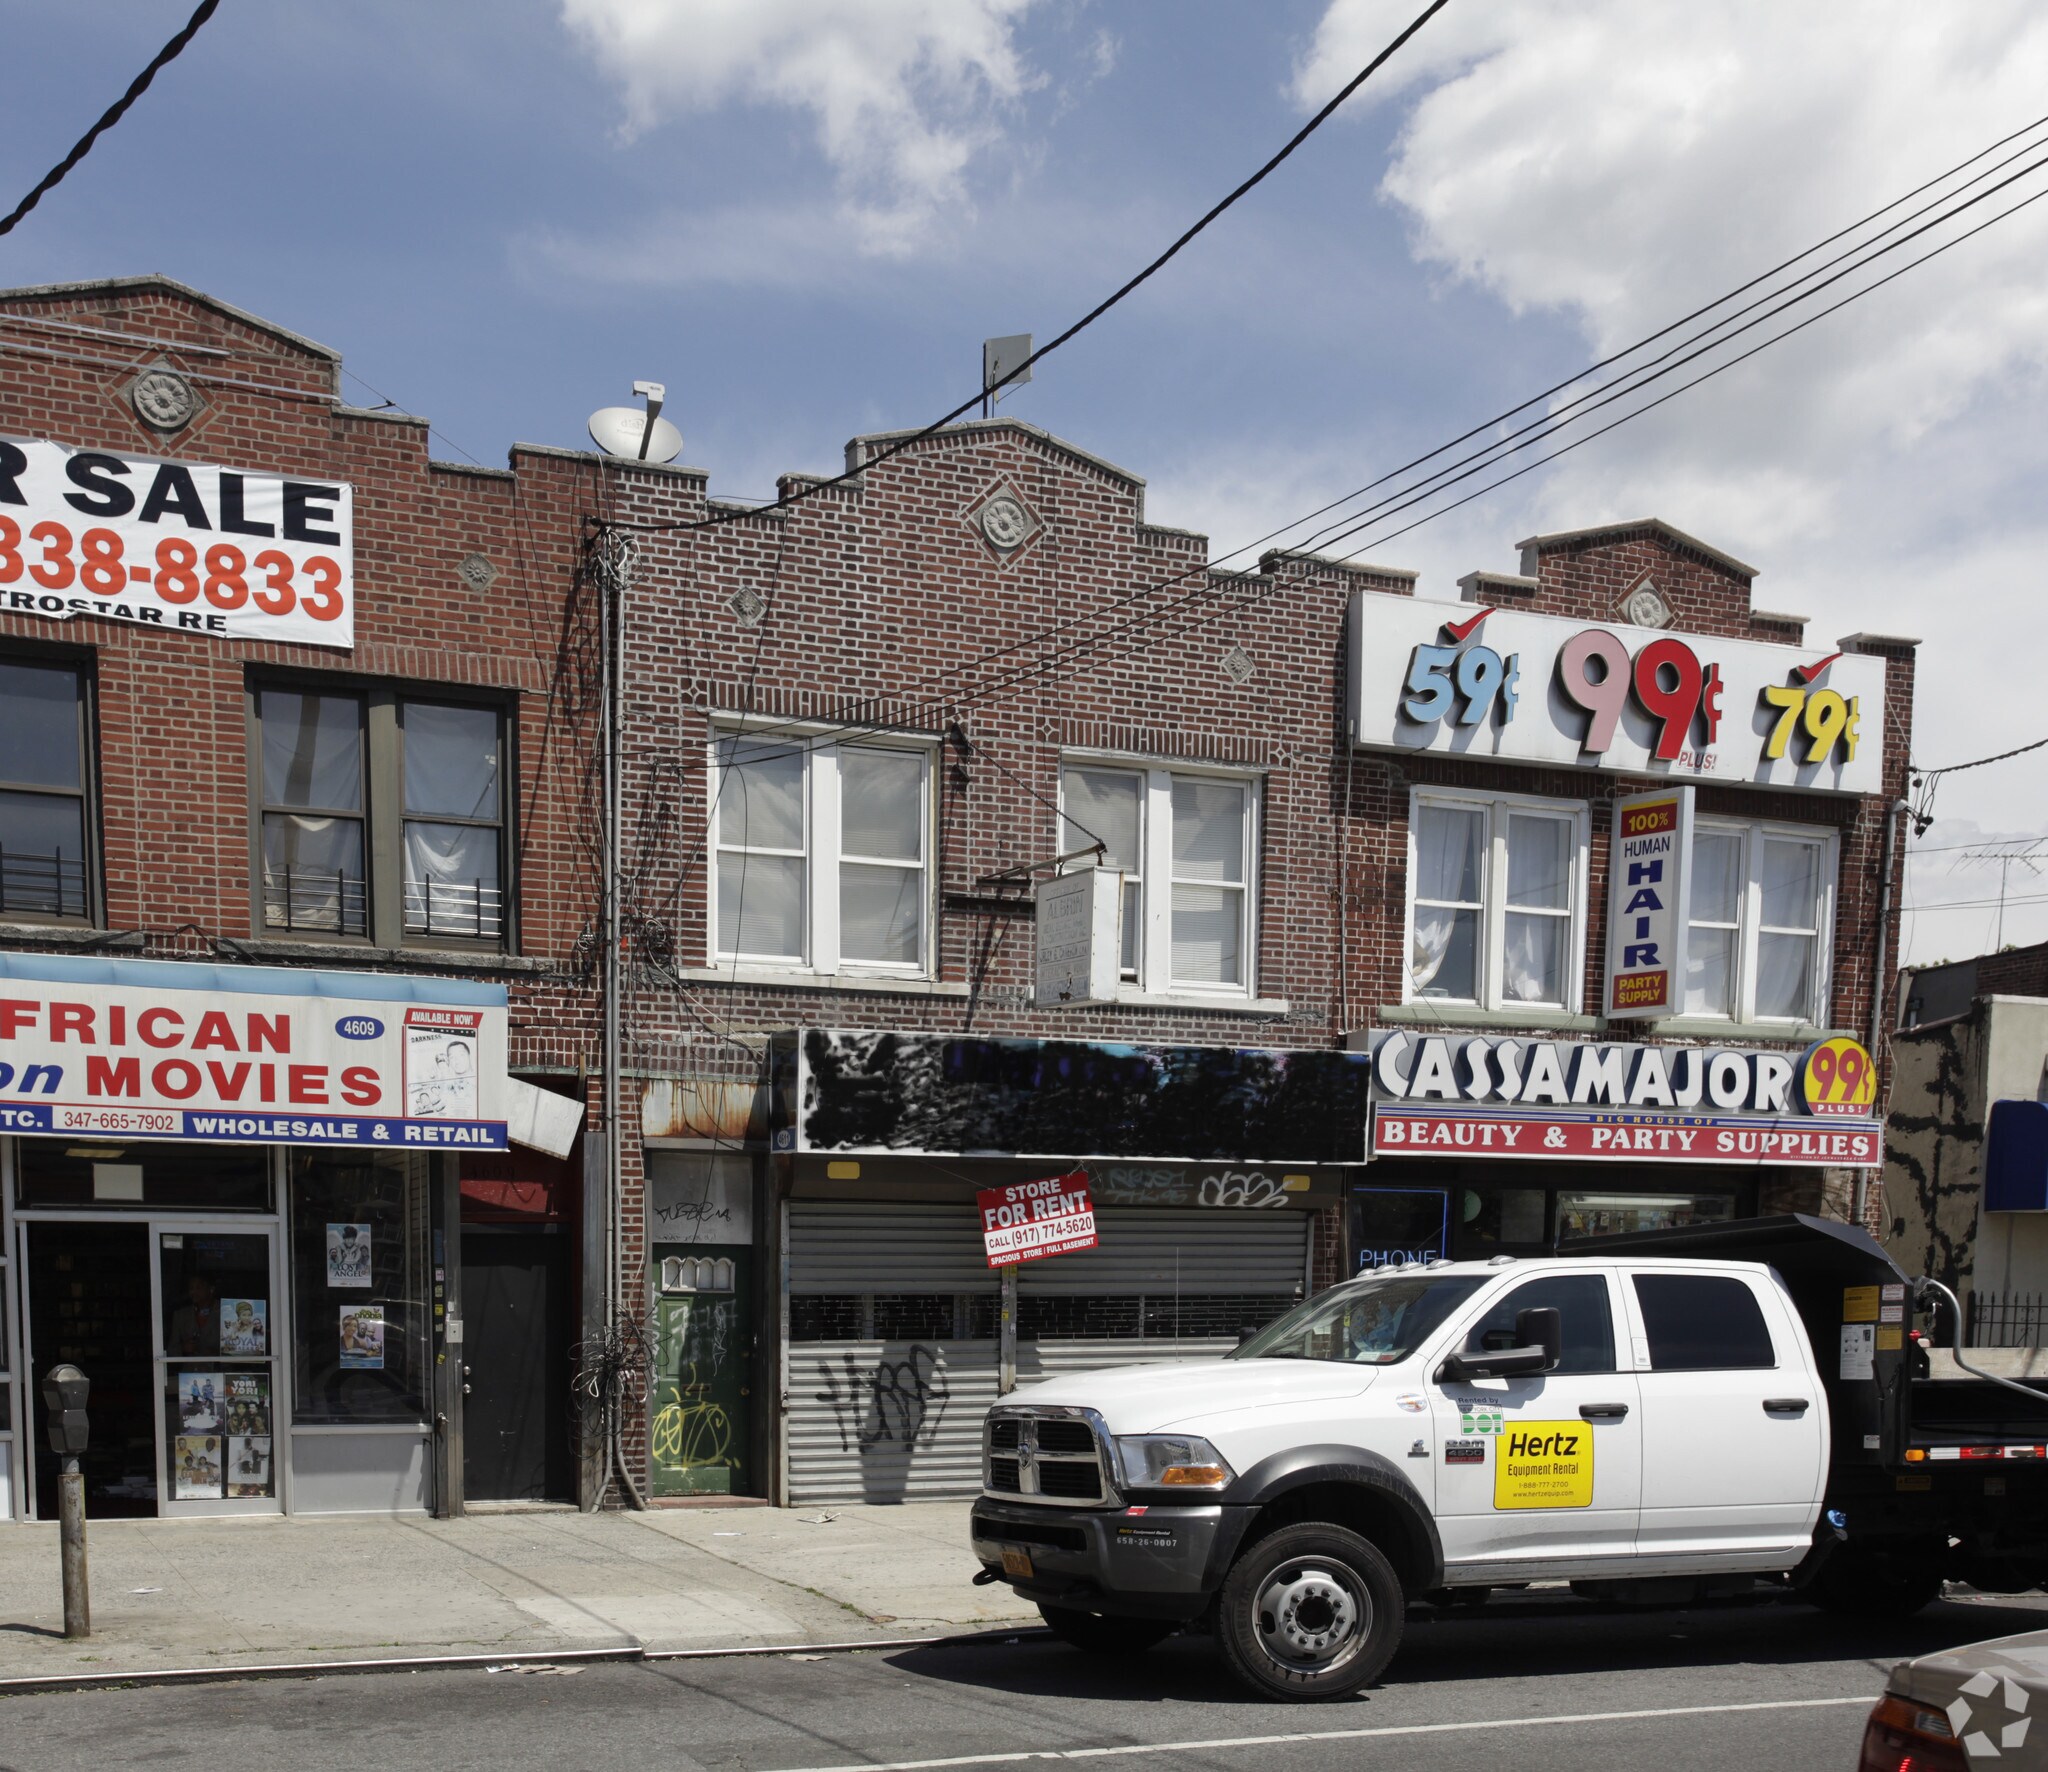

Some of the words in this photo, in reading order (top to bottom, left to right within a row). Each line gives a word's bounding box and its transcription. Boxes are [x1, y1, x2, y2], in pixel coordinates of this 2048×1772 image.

[62, 453, 341, 546] SALE
[0, 590, 163, 624] ROSTAR
[178, 611, 227, 632] RE
[1679, 751, 1718, 771] PLUS!
[1629, 811, 1669, 832] 100%
[1624, 836, 1671, 858] HUMAN
[1624, 859, 1664, 968] HAIR
[1619, 974, 1661, 990] PARTY
[1618, 989, 1660, 1004] SUPPLY
[0, 998, 290, 1054] FRICAN
[344, 1020, 375, 1036] 4609
[411, 1011, 451, 1024] AVAILABLE
[454, 1014, 474, 1026] NOW!
[86, 1055, 382, 1106] MOVIES
[1373, 1031, 1793, 1112] CASSAMAJOR
[1817, 1103, 1863, 1113] PLUS!
[64, 1111, 174, 1131] 347-665-7902
[192, 1117, 358, 1139] WHOLESALE
[372, 1123, 390, 1140] &
[404, 1125, 494, 1144] RETAIL
[1596, 1115, 1624, 1123] BIG
[1633, 1116, 1685, 1125] HOUSE
[1694, 1118, 1714, 1126] OF
[1383, 1121, 1523, 1147] BEAUTY
[1543, 1126, 1567, 1148] &
[1591, 1127, 1698, 1151] PARTY
[1716, 1131, 1870, 1157] SUPPLIES
[1005, 1179, 1061, 1202] STORE
[985, 1203, 1028, 1230] FOR
[1032, 1190, 1086, 1220] RENT
[989, 1234, 1010, 1248] CALL
[1012, 1227, 1040, 1248] (917)
[1042, 1216, 1093, 1238] 774-5620
[991, 1252, 1021, 1265] SPACIOUS
[1023, 1248, 1043, 1259] STORE
[1047, 1243, 1062, 1254] FULL
[1062, 1237, 1094, 1251] BASEMENT
[337, 1263, 359, 1271] LOST
[231, 1387, 258, 1395] YORI
[1458, 1396, 1487, 1404] Rented
[1489, 1396, 1499, 1406] by
[1462, 1414, 1502, 1434] DOT
[1448, 1449, 1483, 1457] 4500
[1508, 1433, 1578, 1457] Hertz
[1508, 1464, 1552, 1477] Equipment
[1553, 1463, 1579, 1475] Rental
[1512, 1490, 1574, 1498] www.hertzequip.com
[1518, 1481, 1569, 1489] 1-888-777-2700
